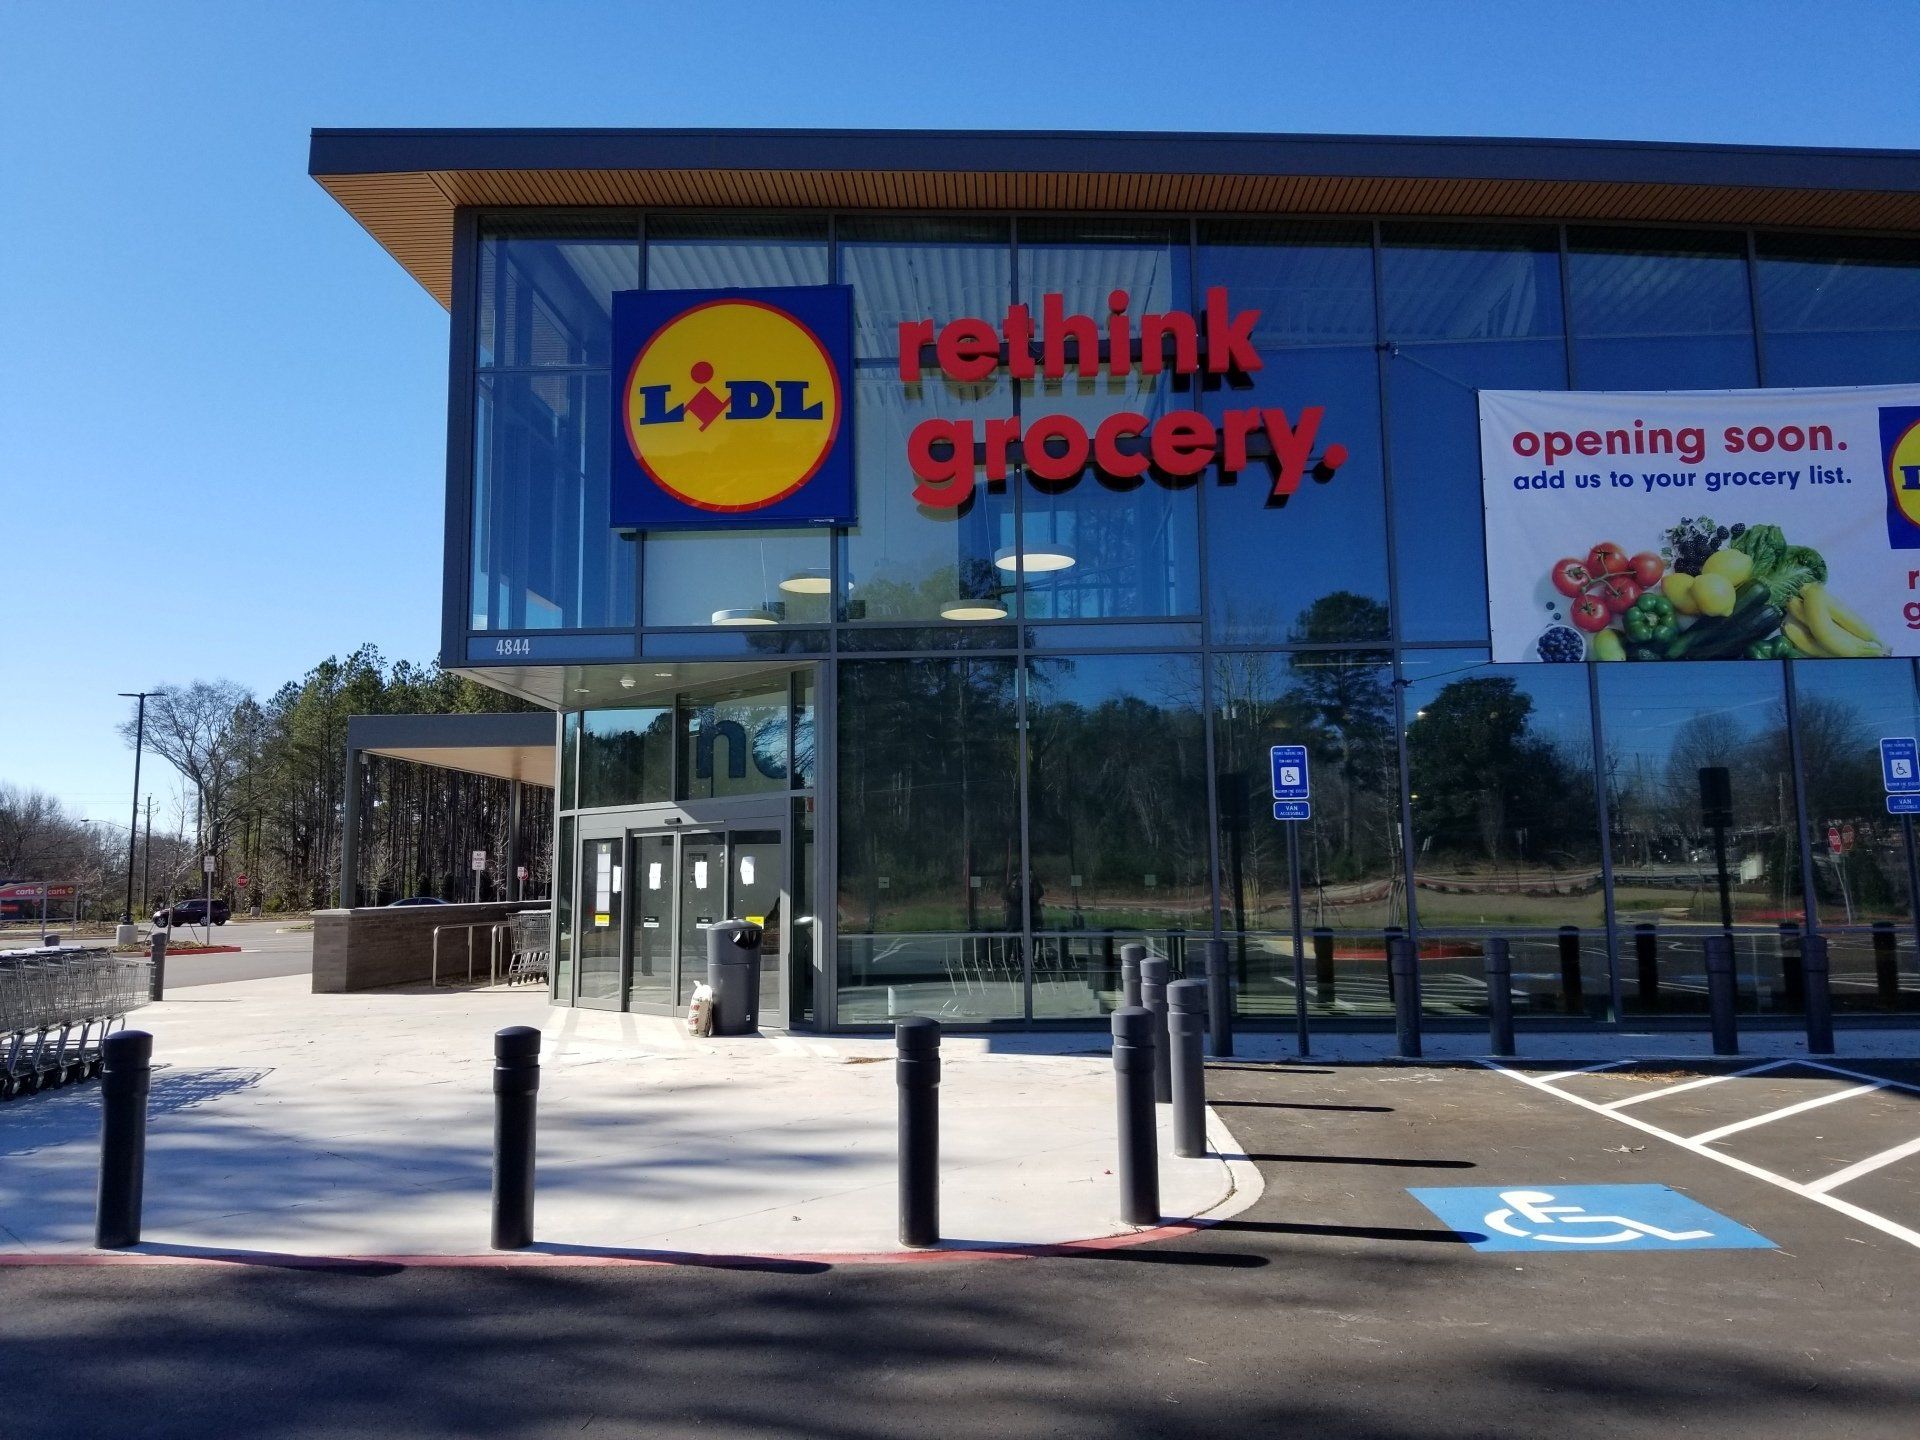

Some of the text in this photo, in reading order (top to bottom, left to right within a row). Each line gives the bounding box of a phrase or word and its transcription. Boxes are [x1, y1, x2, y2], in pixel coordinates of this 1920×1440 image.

[900, 288, 1261, 383] rethink
[909, 407, 1348, 509] grocery.
[1513, 419, 1848, 466] opening soon.
[1513, 464, 1852, 493] add us to your grocery list.
[496, 638, 530, 656] 4844
[16, 888, 66, 896] carts carts
